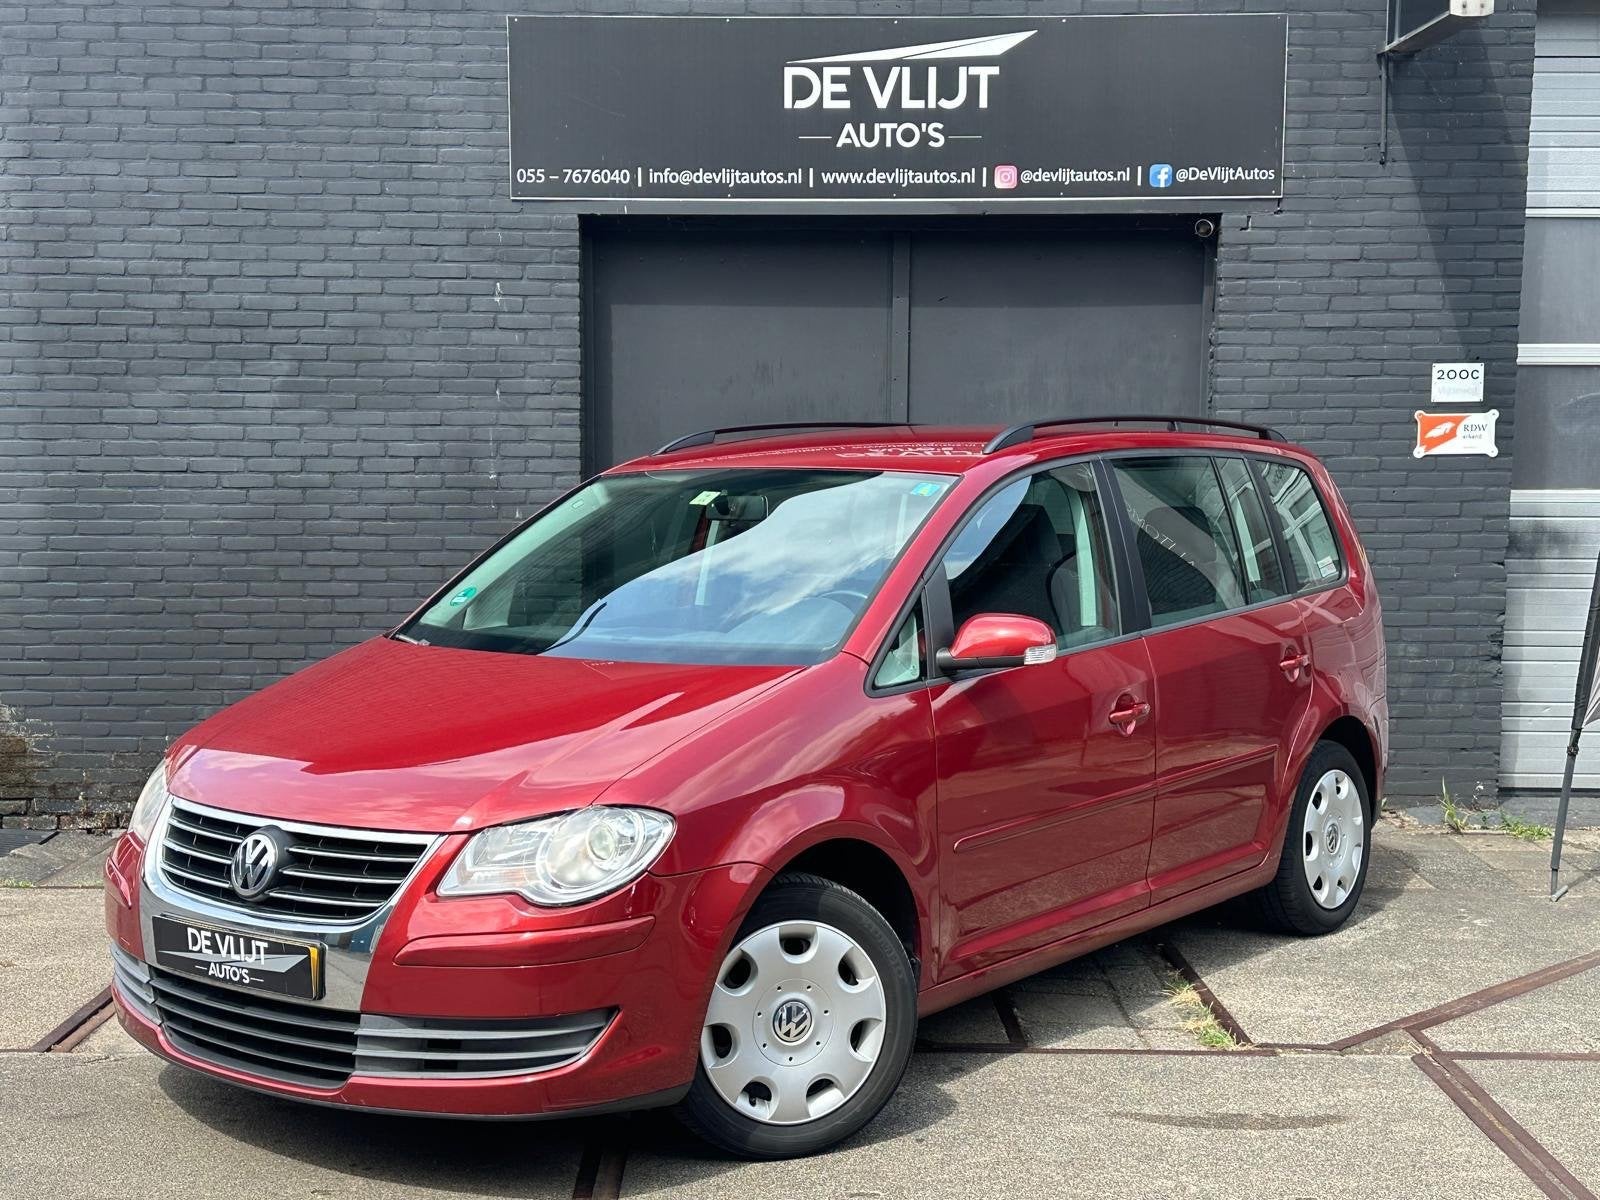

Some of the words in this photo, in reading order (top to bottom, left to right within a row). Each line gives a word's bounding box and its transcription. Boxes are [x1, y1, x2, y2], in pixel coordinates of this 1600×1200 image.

[783, 66, 851, 109] DE
[862, 66, 1000, 110] VLIJT
[836, 122, 945, 148] AUTO'S
[516, 168, 546, 184] 055
[562, 168, 631, 185] 7676040
[648, 167, 802, 188] info@devlijtautos.nl
[821, 167, 976, 188] www.devlijtautos.nl
[1020, 167, 1130, 186] @devlijtautos.nl
[1175, 167, 1275, 184] @DeVlijtAutos
[1463, 423, 1488, 432] RDW
[231, 832, 277, 896] VW
[186, 926, 213, 956] DE
[214, 931, 269, 966] VLIJT
[208, 961, 250, 984] AUTO'S
[773, 1000, 813, 1043] VW
